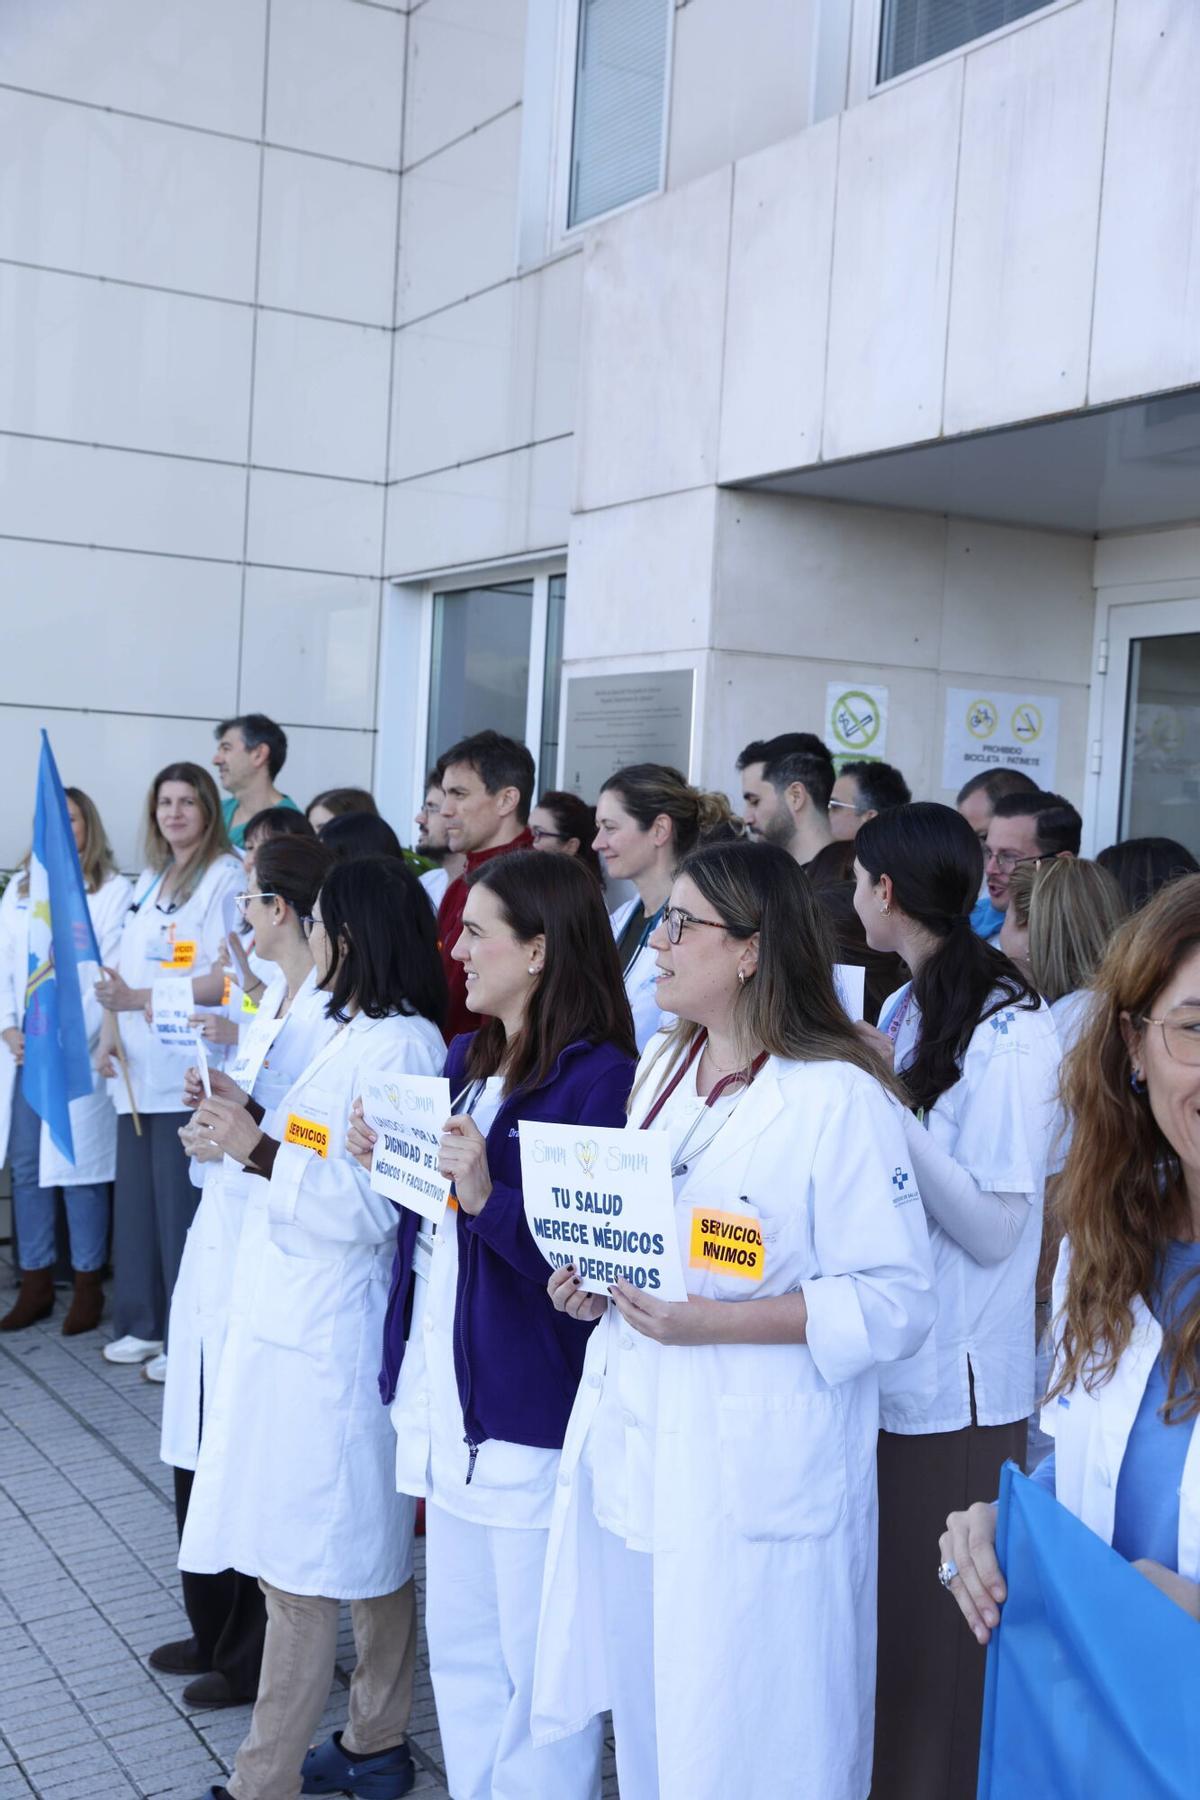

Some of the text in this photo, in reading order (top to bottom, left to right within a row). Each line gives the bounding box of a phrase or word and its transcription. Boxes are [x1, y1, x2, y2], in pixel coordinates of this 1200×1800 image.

[964, 753, 1000, 763] BICICLETA
[983, 744, 1023, 755] PROHIBIDO
[289, 1122, 327, 1146] SERVICIOS
[411, 1127, 428, 1142] POR
[384, 1134, 421, 1163] DIGNIDAD
[423, 1153, 432, 1169] DE
[375, 1157, 401, 1181] MÉDICOS
[405, 1174, 446, 1203] FACULTATIVOS
[551, 1187, 623, 1217] TU SALUD
[533, 1217, 665, 1256] MERECE MÉDICOS
[701, 1218, 762, 1247] SERVICIOS
[579, 1256, 661, 1290] DERECHOS
